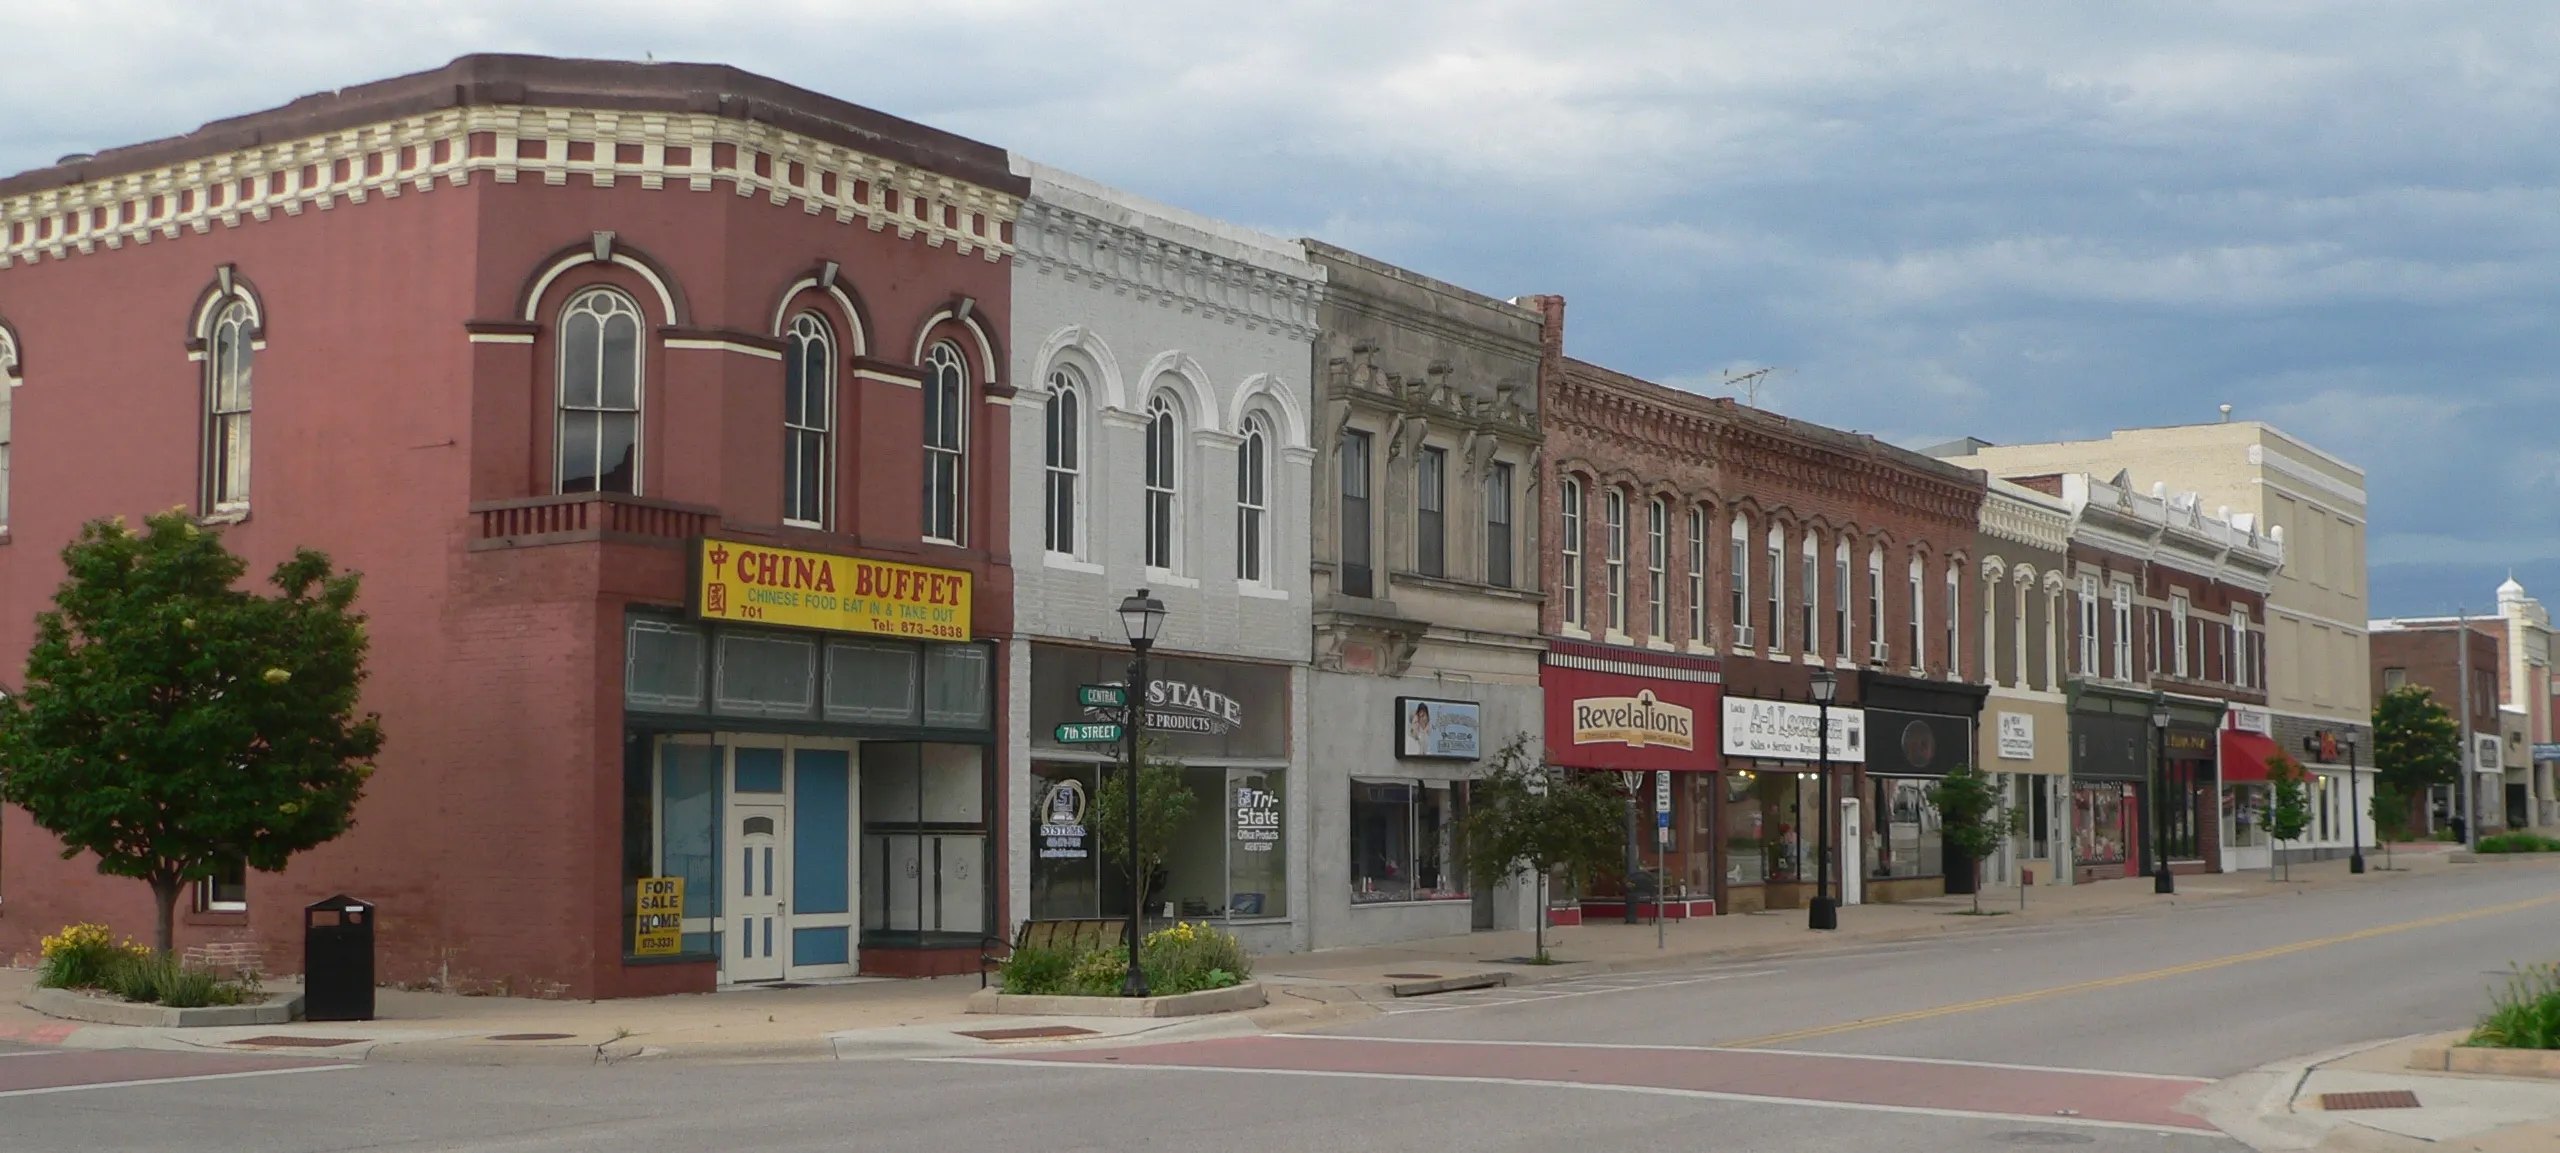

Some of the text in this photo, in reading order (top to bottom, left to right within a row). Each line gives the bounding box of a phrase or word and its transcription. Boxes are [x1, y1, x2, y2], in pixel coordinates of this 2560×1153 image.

[737, 551, 963, 607] CHINA BUFFET
[739, 605, 763, 619] 701
[748, 588, 955, 623] CHINESE FOOD EAT IN & TAKE OUT
[872, 617, 963, 639] Tel: 873-3838
[1087, 688, 1119, 704] CENTRAL
[1156, 713, 1211, 731] PRODUCTS
[1577, 693, 1689, 737] Revelations
[1063, 725, 1116, 740] 7th STREET
[1251, 789, 1279, 809] Tri-
[1237, 807, 1279, 825] State
[1040, 824, 1086, 837] SYSTEMS
[1237, 829, 1279, 840] Office Products
[645, 881, 674, 895] FOR
[641, 895, 679, 910] SALE
[638, 912, 681, 935] HOME
